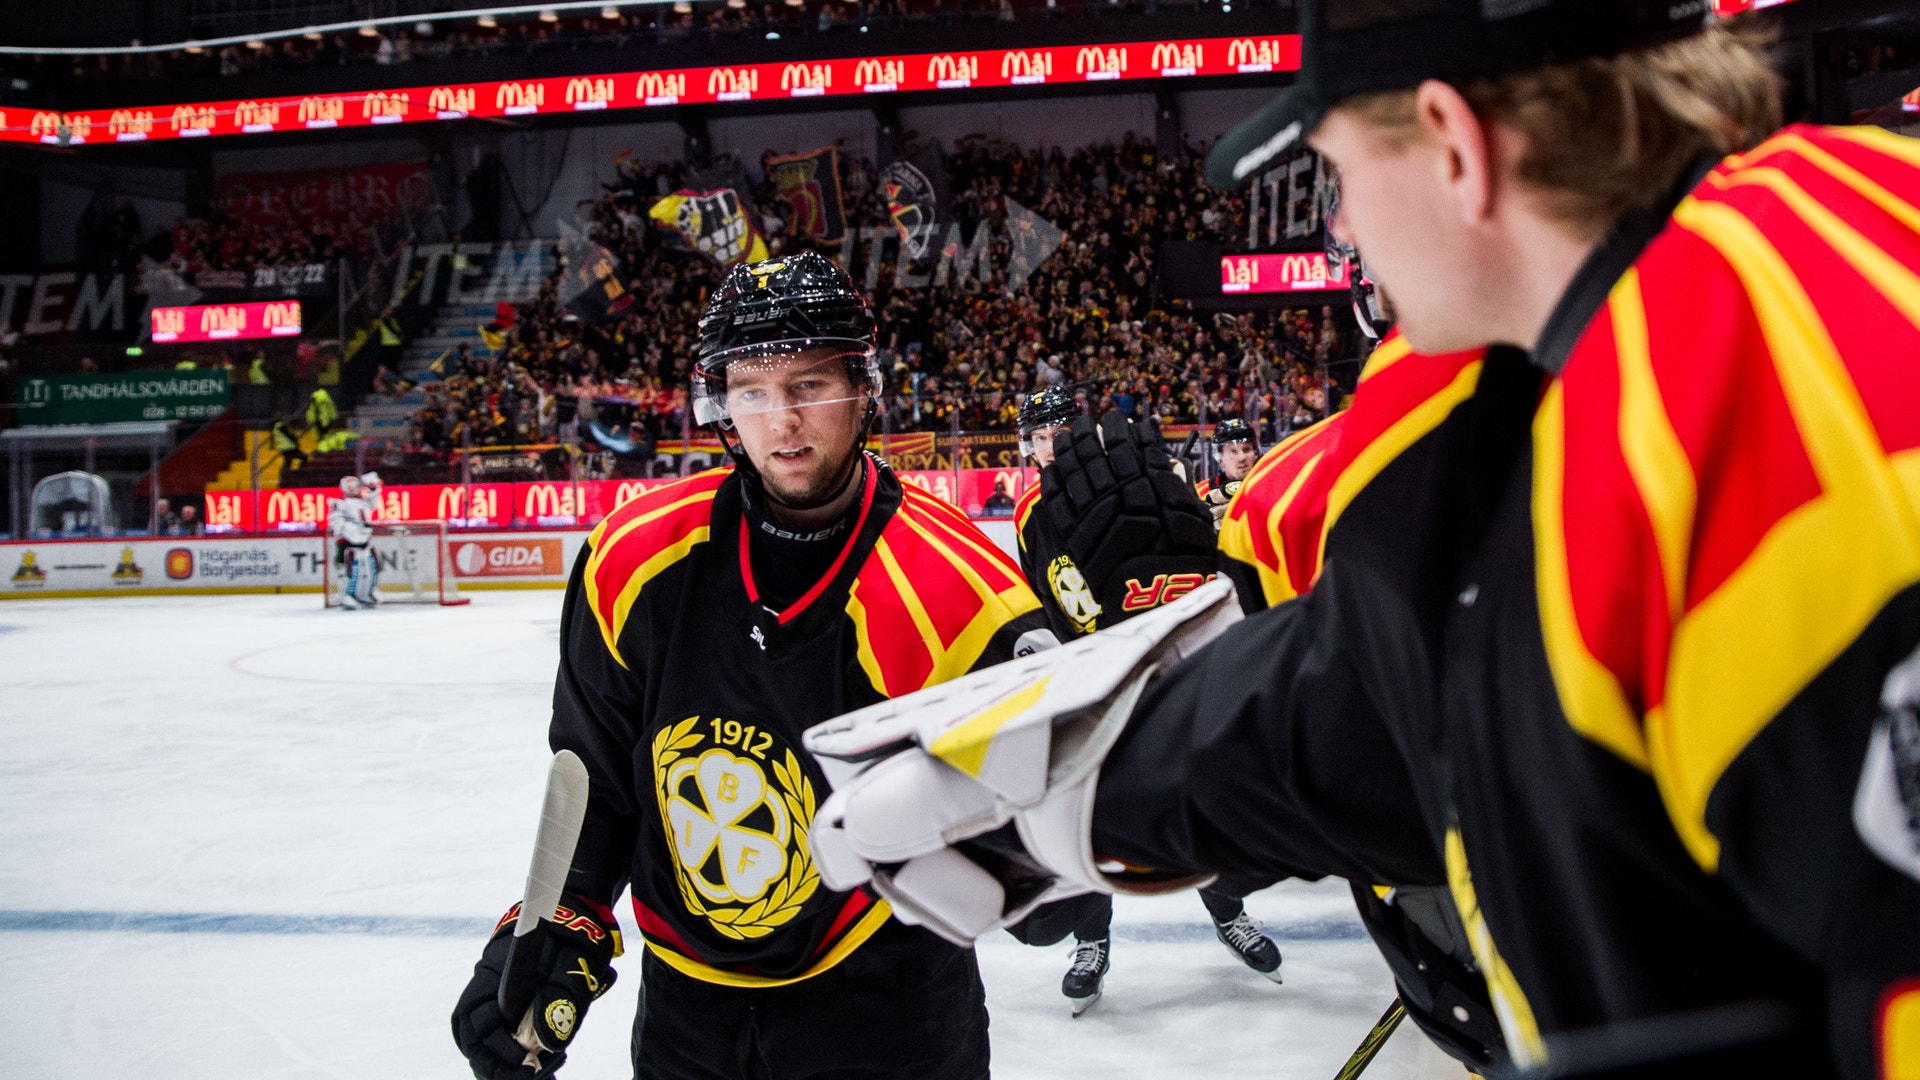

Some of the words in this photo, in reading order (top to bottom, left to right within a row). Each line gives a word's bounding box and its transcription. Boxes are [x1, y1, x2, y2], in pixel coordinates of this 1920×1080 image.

[267, 490, 325, 523] Mål
[489, 545, 544, 567] GIDA
[710, 717, 774, 760] 1912
